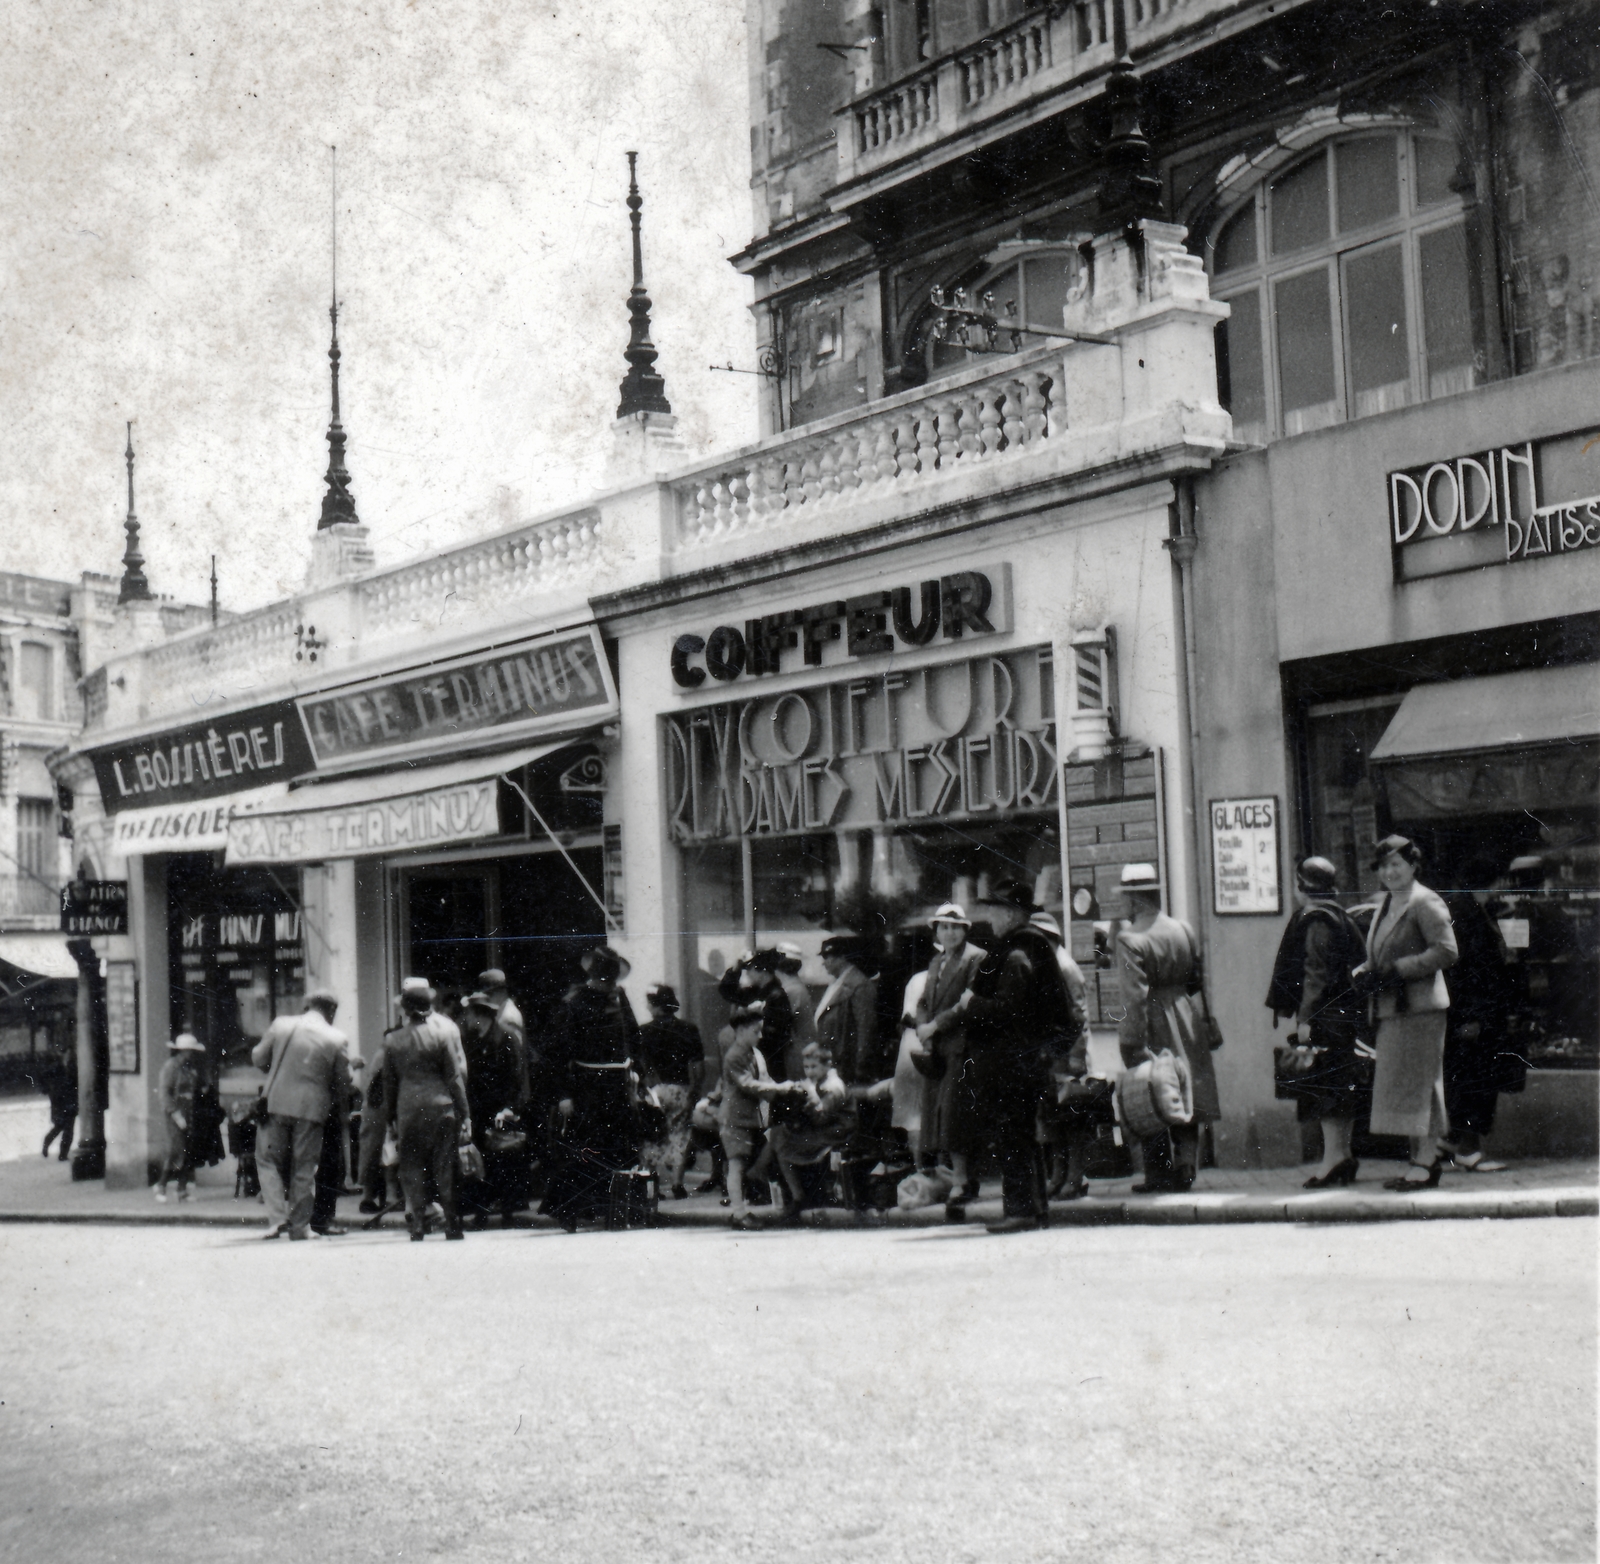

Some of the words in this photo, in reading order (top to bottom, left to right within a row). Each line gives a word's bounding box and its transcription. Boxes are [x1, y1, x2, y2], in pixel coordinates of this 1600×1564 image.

[1391, 442, 1537, 543] DODIN
[671, 571, 996, 688] COIFFEUR
[407, 645, 597, 729] TERMINUS
[135, 722, 283, 792] BOSSIÈRES
[326, 786, 489, 851] TERMINUS
[739, 756, 850, 836] DAMES
[1214, 804, 1272, 831] GLACES
[69, 916, 119, 931] PIANOS
